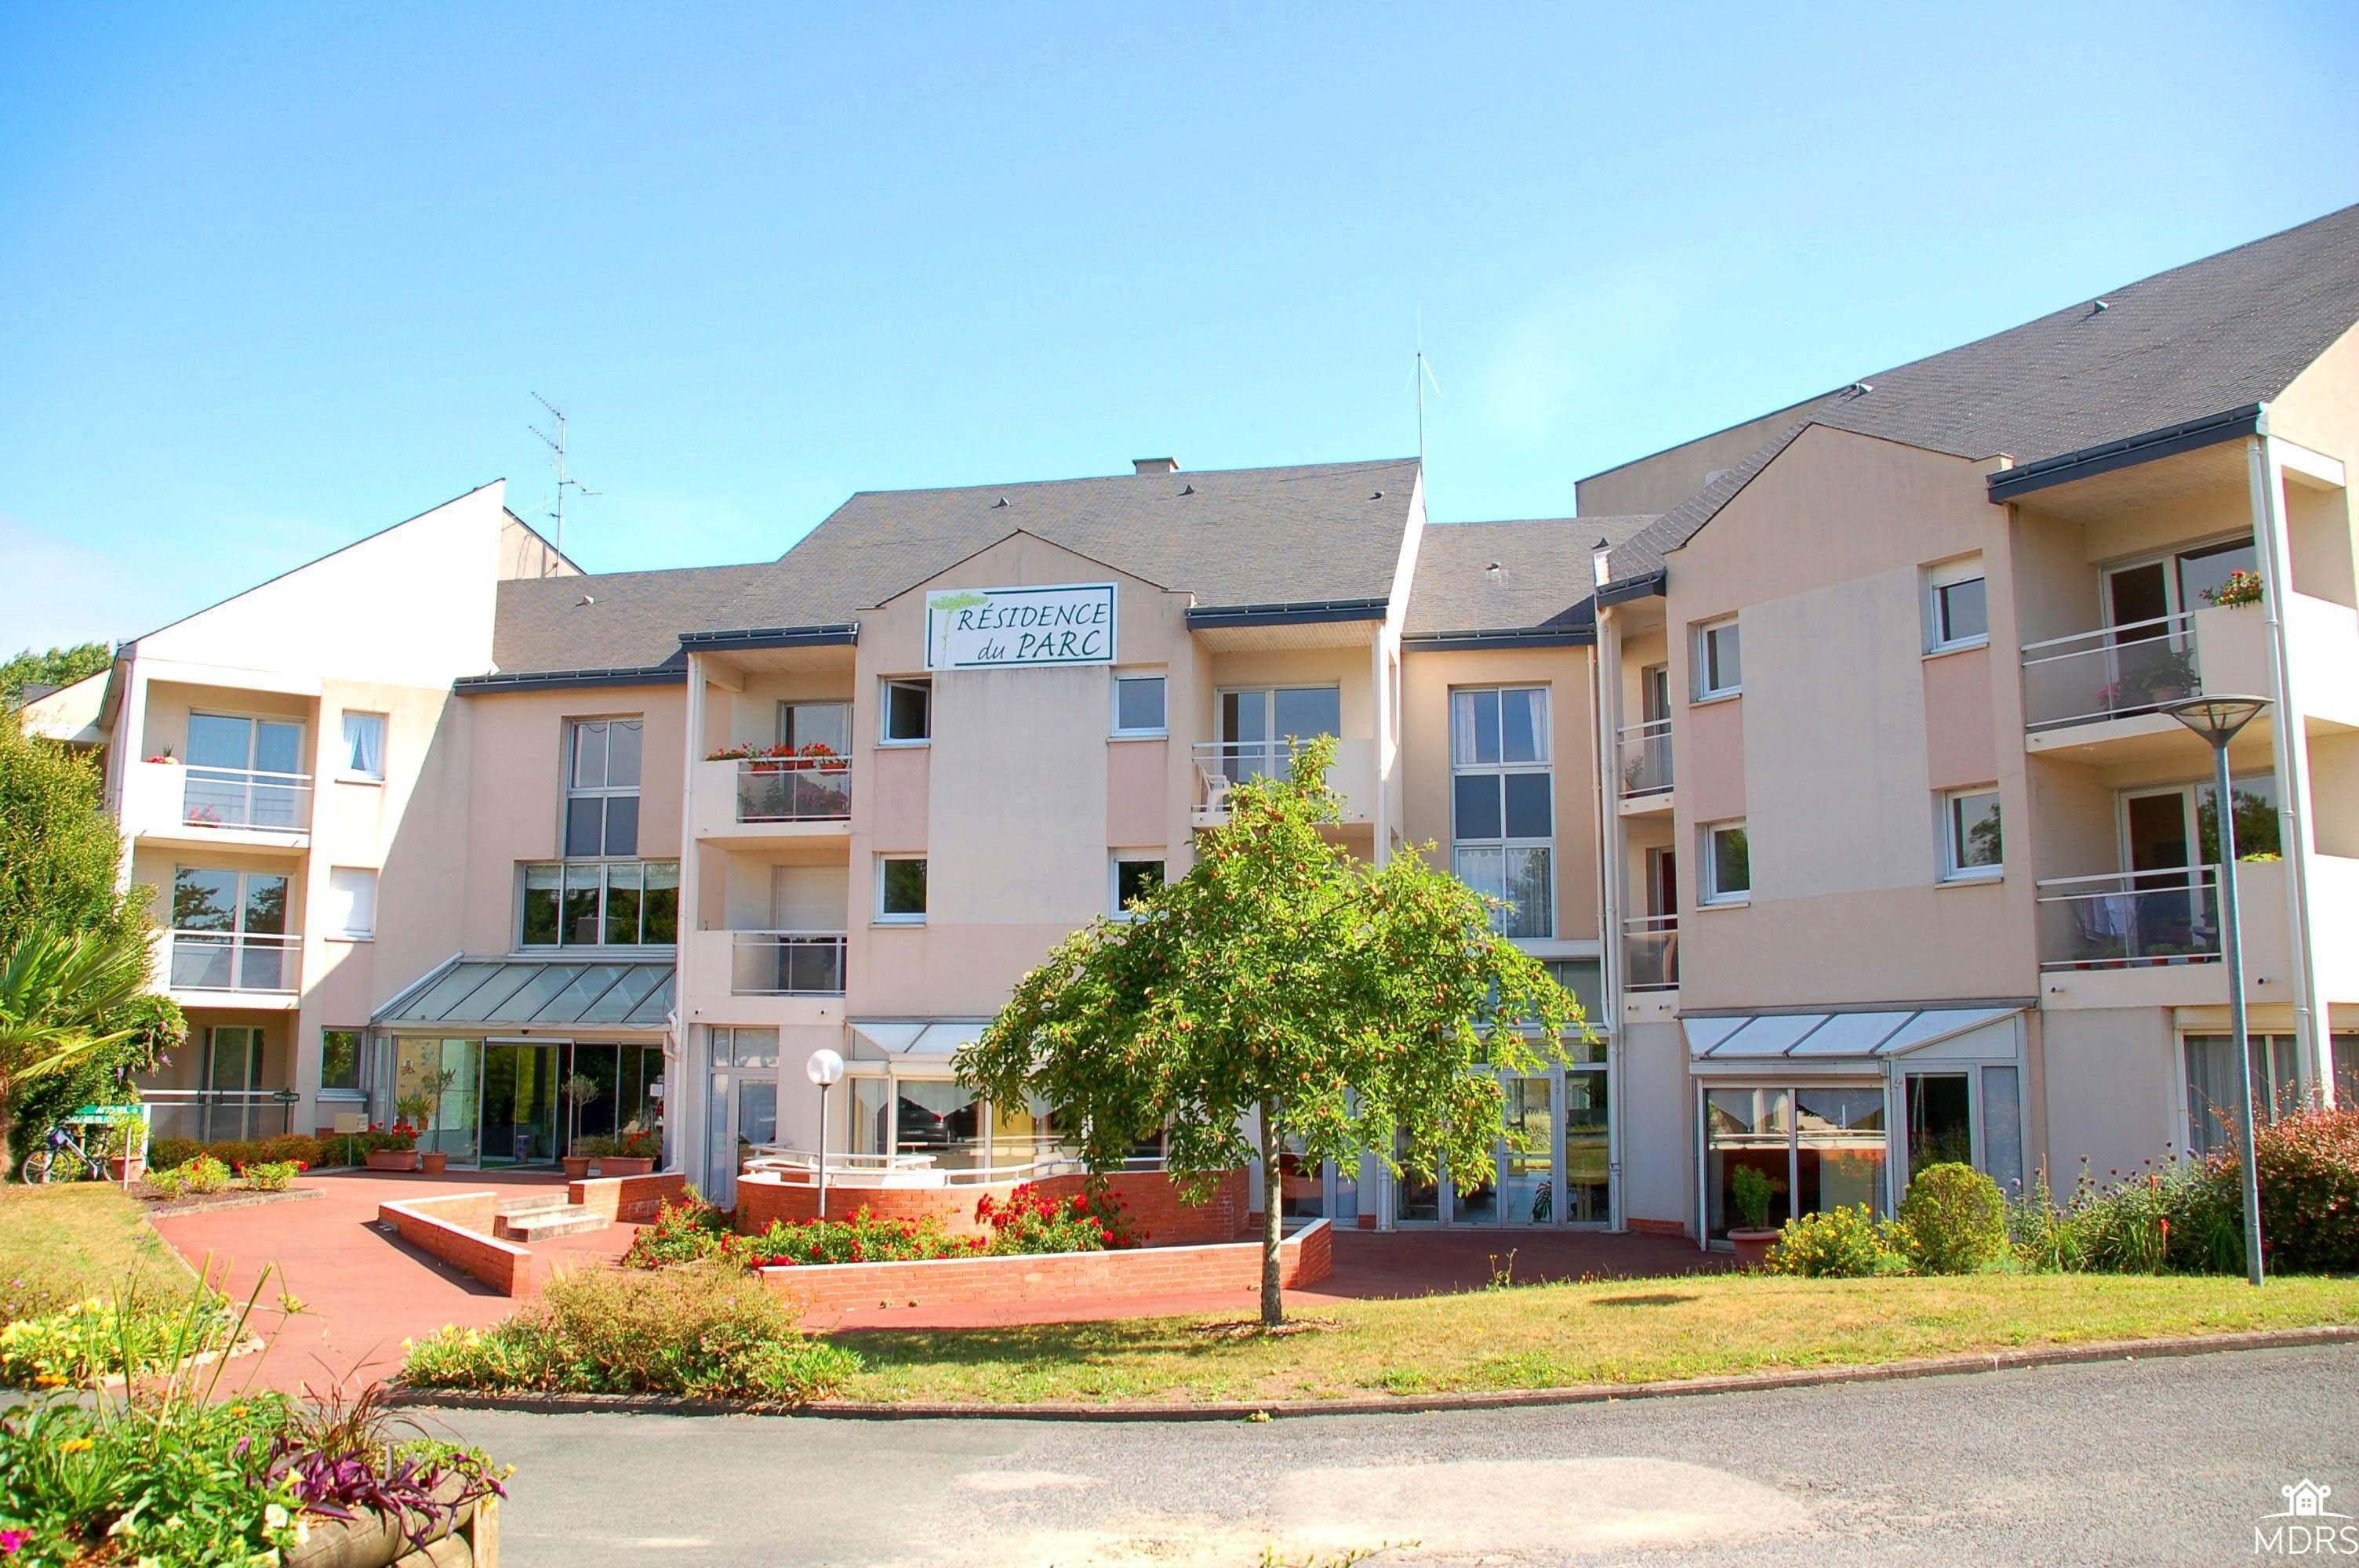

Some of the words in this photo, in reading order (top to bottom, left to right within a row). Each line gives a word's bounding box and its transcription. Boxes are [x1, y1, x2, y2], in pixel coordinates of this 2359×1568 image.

[957, 602, 1108, 630] RÉSIDENCE
[977, 638, 1005, 660] du
[1016, 630, 1101, 659] PARC
